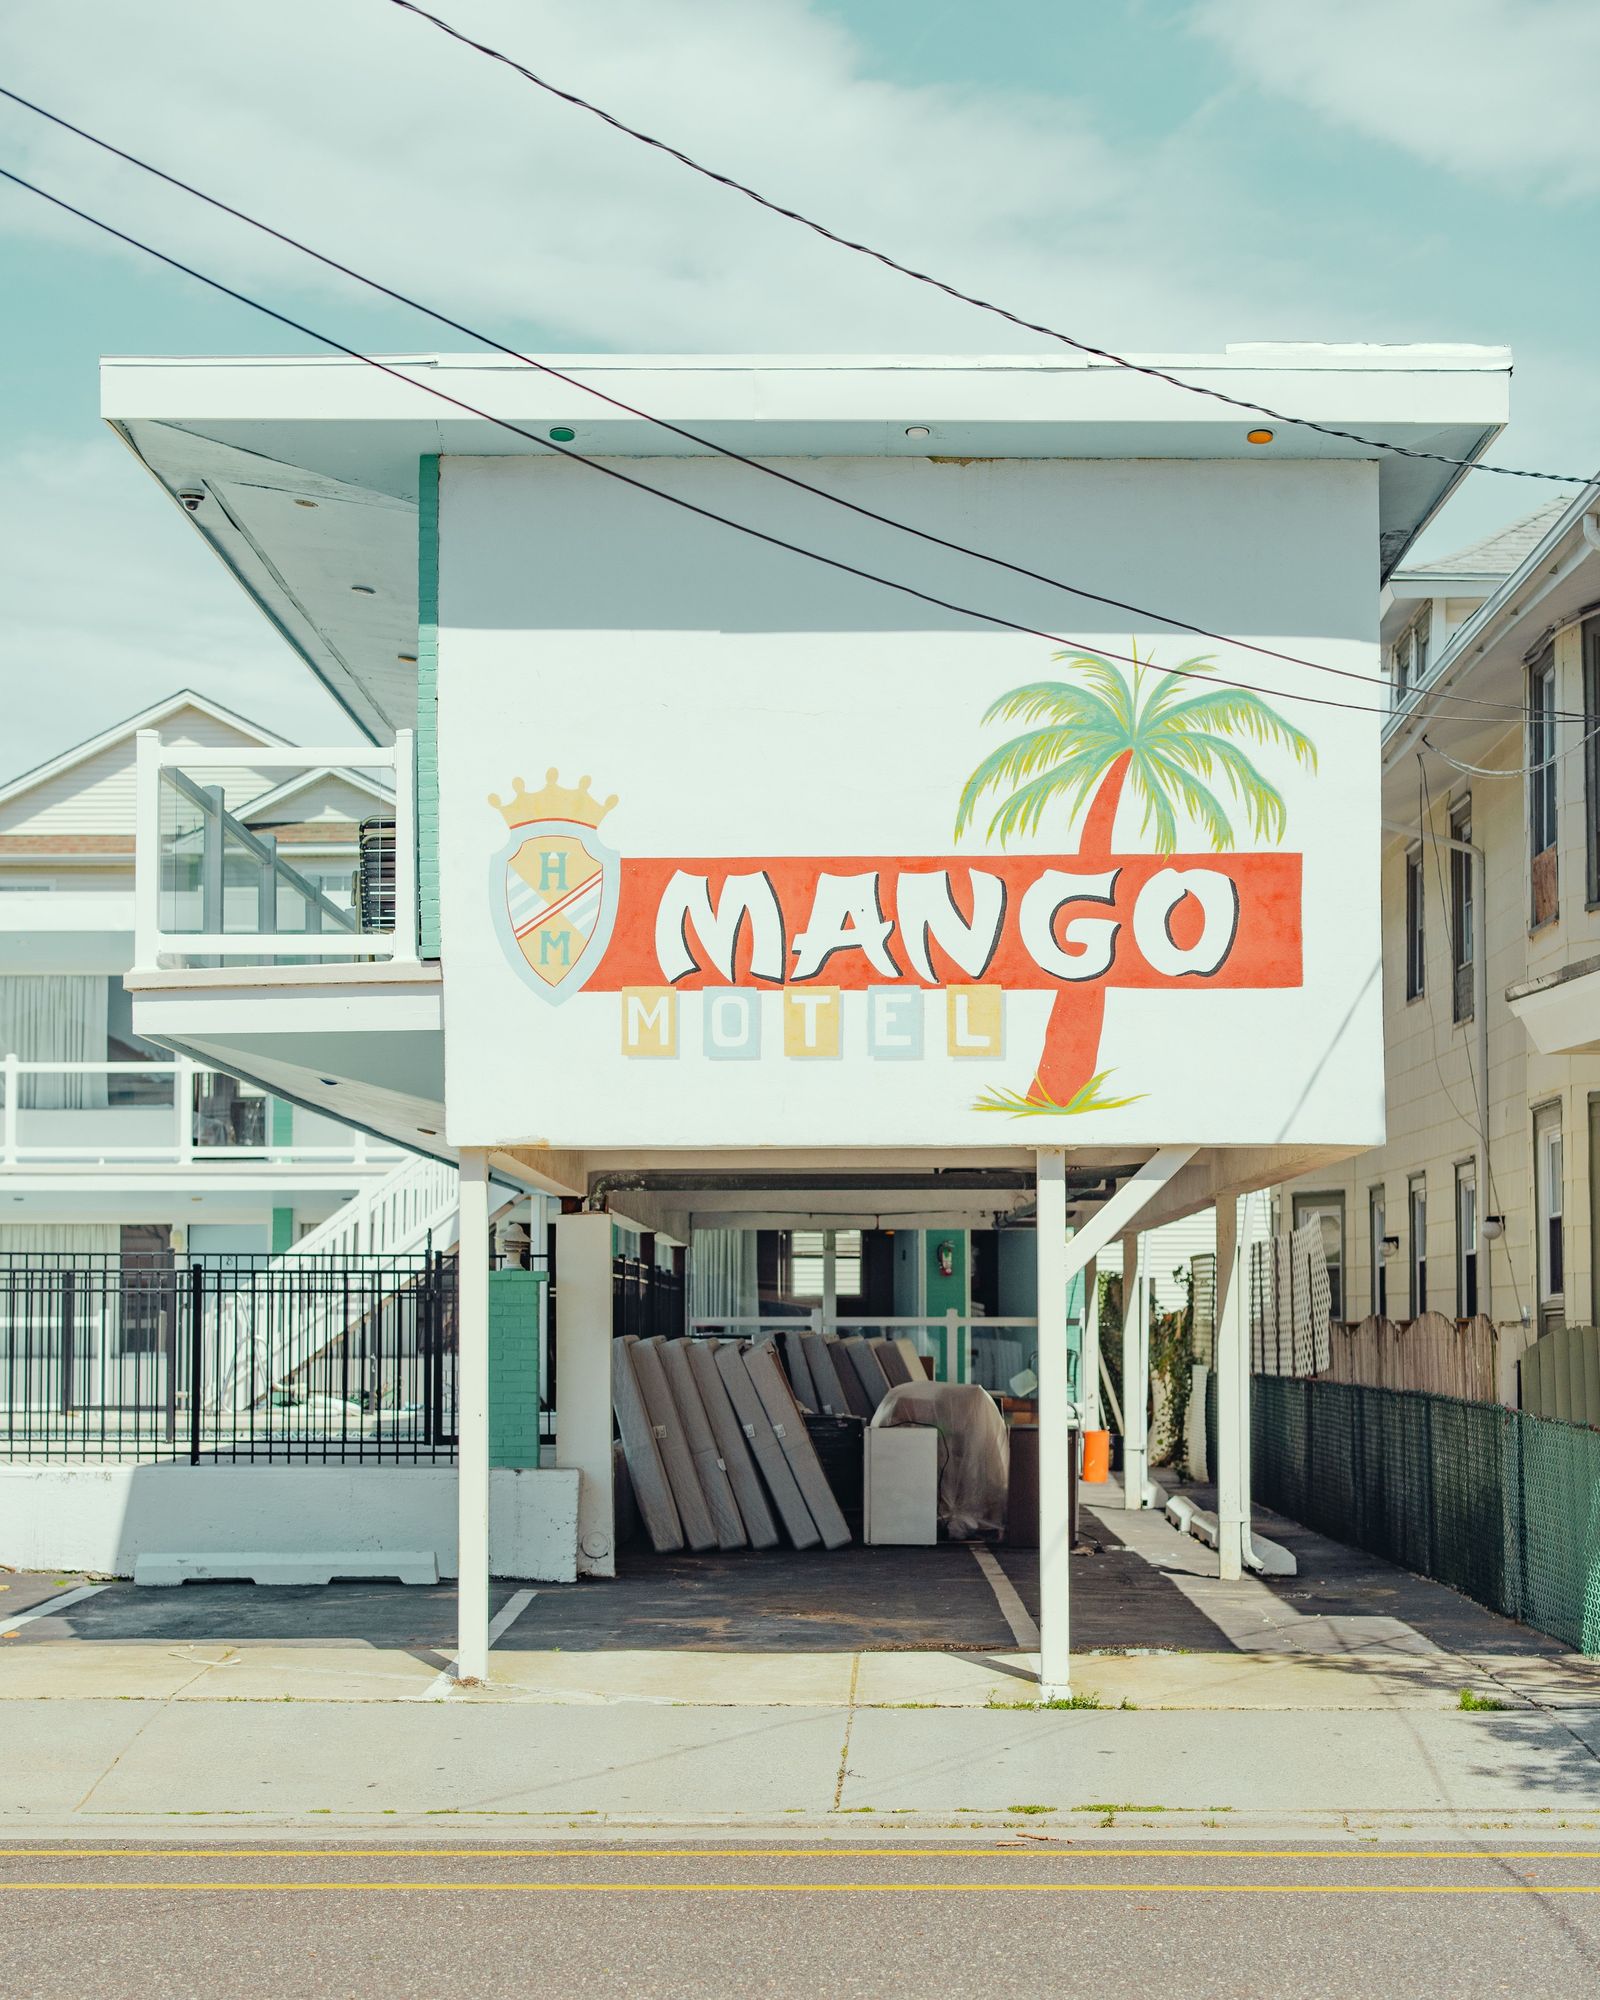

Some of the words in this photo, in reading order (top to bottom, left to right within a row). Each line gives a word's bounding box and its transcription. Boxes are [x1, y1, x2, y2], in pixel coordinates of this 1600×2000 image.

[539, 851, 568, 891] H
[539, 930, 572, 966] M
[654, 867, 1239, 985] MANGO
[627, 993, 991, 1048] MOTEL
